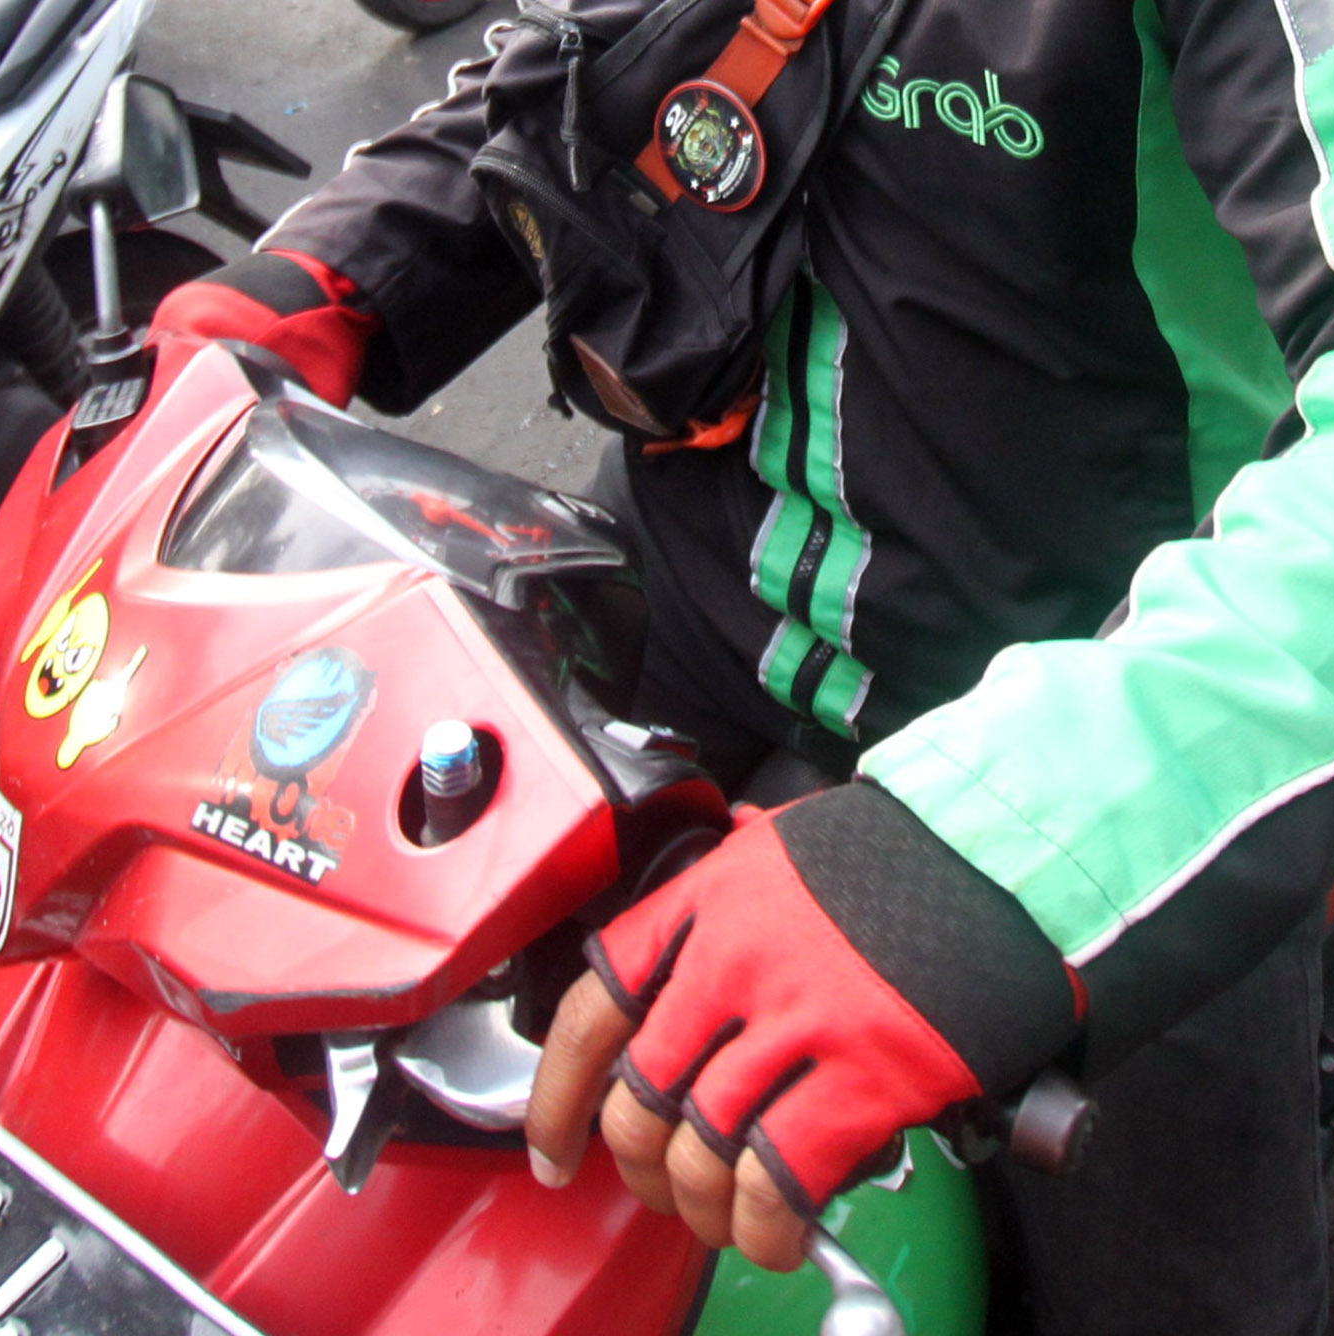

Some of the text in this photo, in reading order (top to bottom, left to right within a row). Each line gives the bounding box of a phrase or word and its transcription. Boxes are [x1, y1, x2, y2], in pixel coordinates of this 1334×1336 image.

[665, 103, 688, 138] 2
[862, 54, 1045, 160] Grab
[190, 800, 337, 884] HEART
